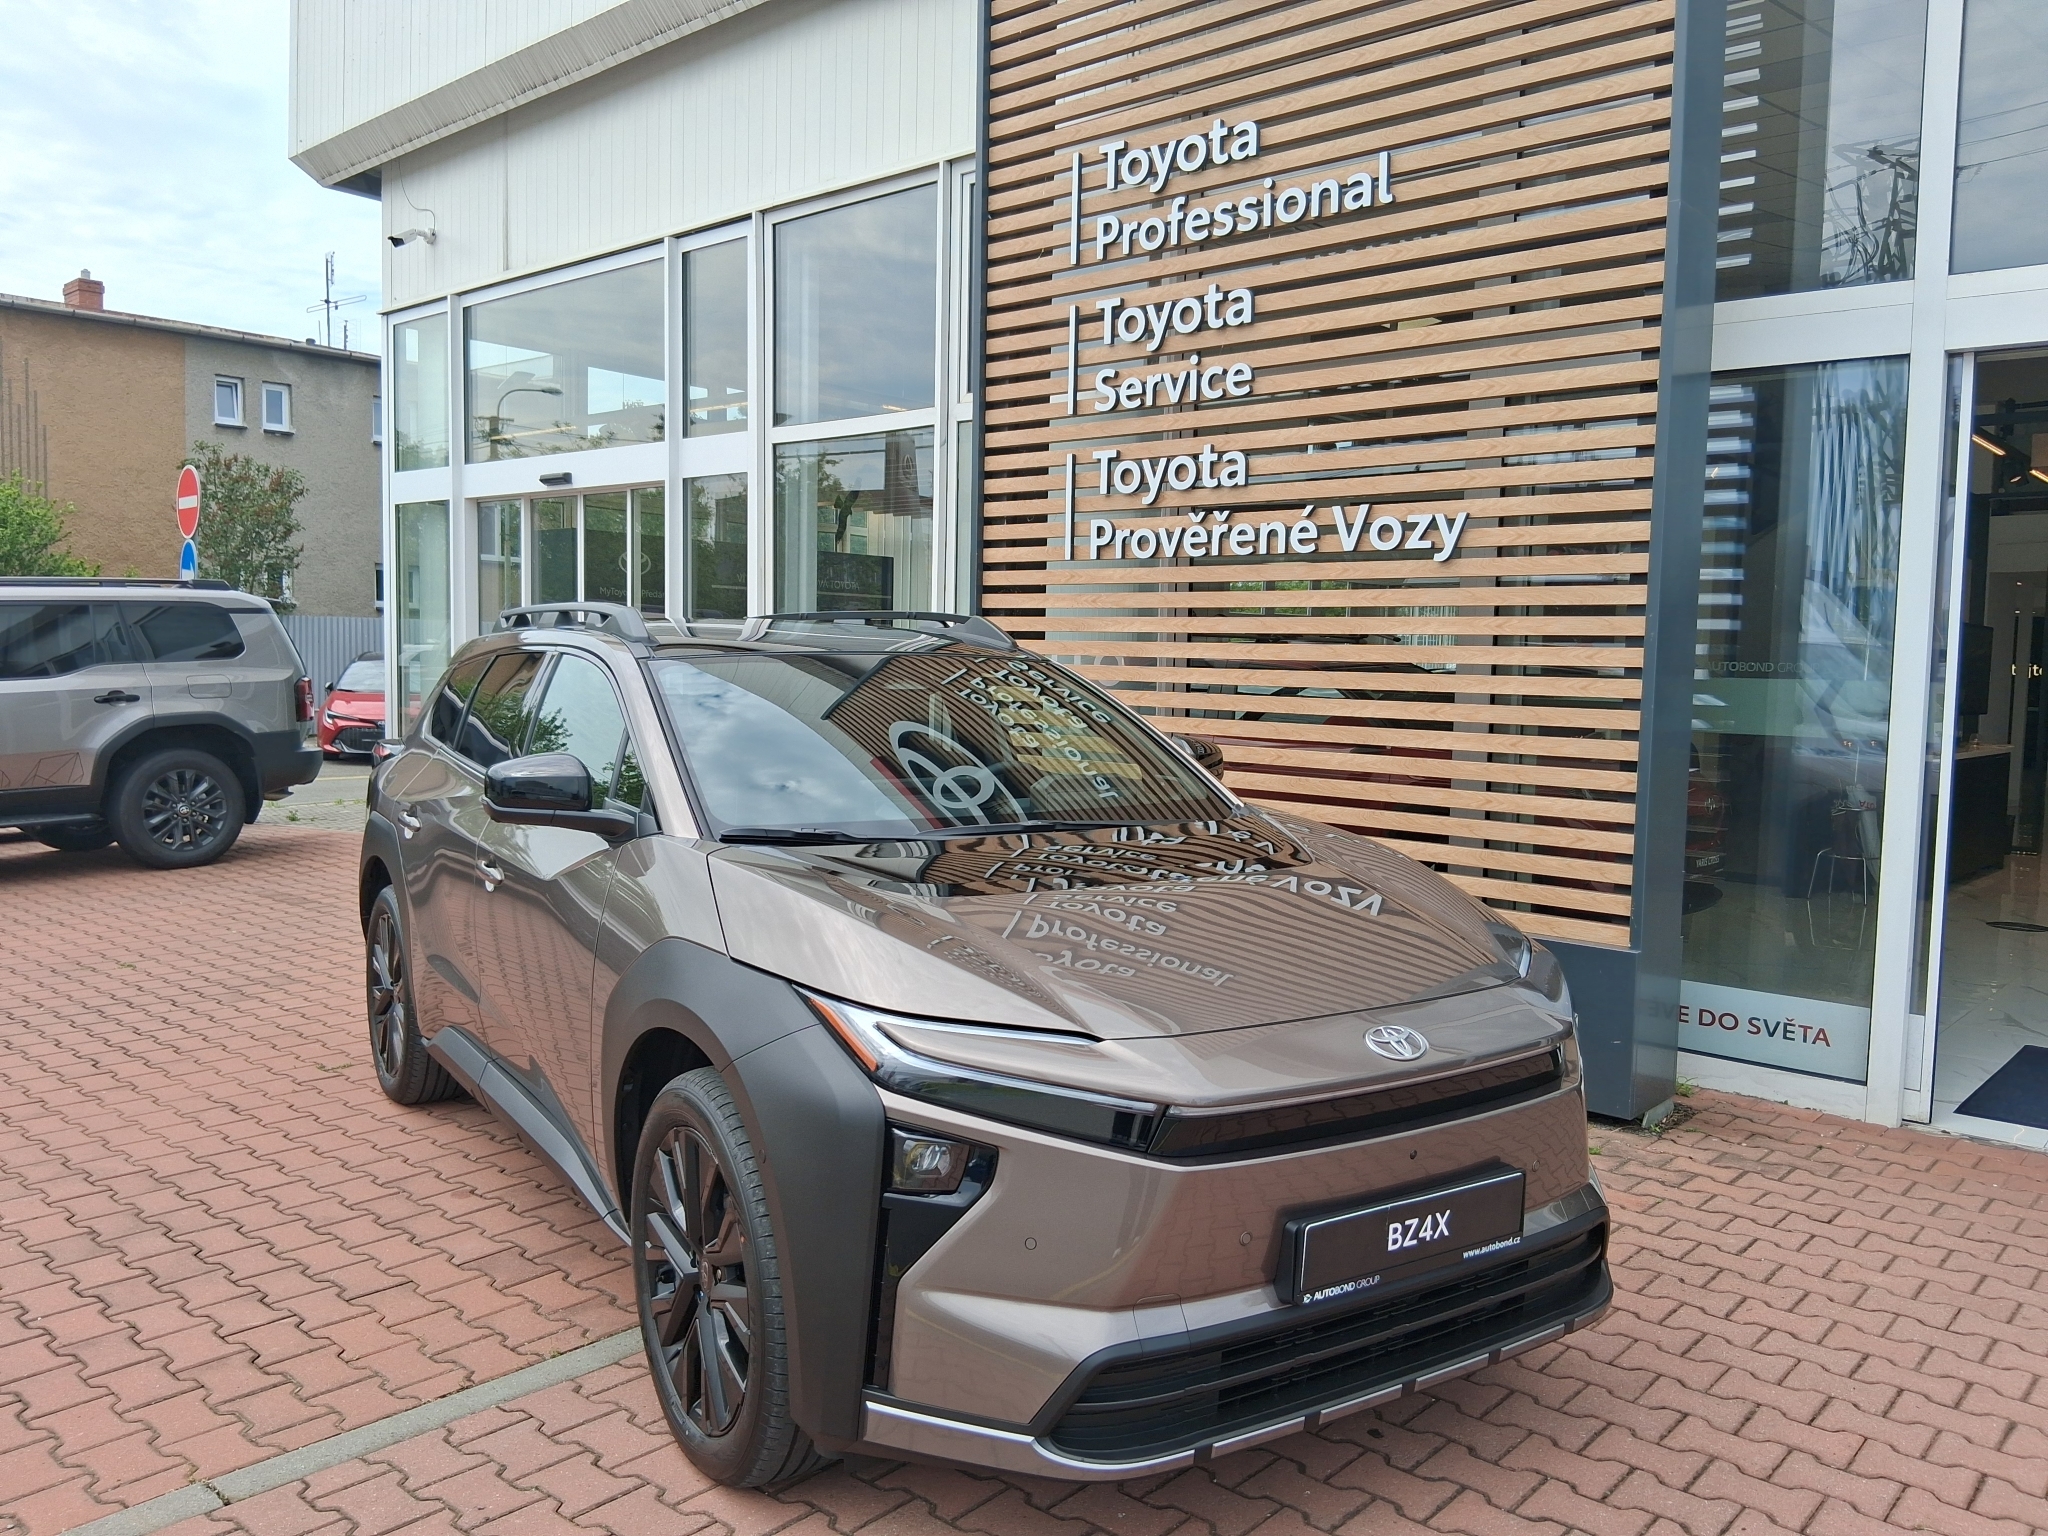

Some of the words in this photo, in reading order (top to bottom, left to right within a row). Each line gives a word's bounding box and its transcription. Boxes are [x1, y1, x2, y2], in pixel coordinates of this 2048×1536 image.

[1099, 118, 1260, 193] Toyota
[1096, 151, 1395, 261] Professional
[1096, 283, 1255, 352] Toyota
[1094, 355, 1254, 412] Service
[1093, 443, 1249, 504] Toyota
[1089, 504, 1319, 560] Prověřené
[1332, 503, 1469, 562] Vozy
[1698, 1008, 1739, 1031] DO
[1746, 1016, 1832, 1048] SVĚTA
[1387, 1209, 1451, 1252] BZ4X
[1462, 1235, 1521, 1260] www.autobond.cz
[1313, 1281, 1356, 1302] AUTOBOND
[1356, 1274, 1381, 1289] GROUP
